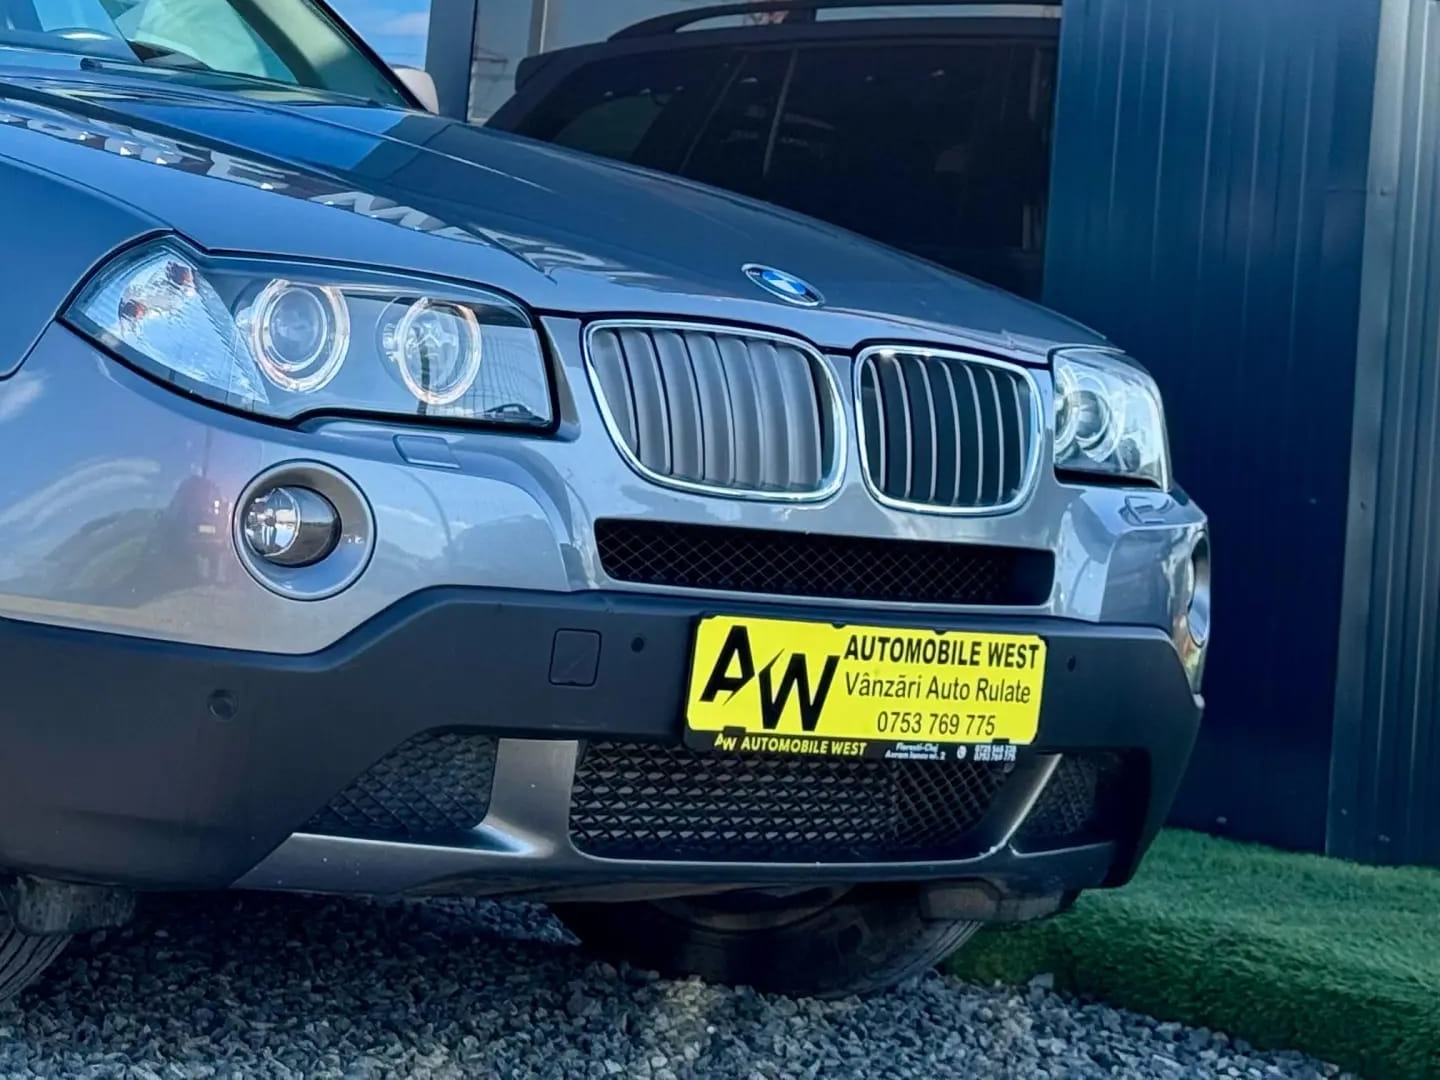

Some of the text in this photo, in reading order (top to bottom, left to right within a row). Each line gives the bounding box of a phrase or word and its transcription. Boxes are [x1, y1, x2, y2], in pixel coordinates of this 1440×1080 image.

[843, 634, 1040, 670] AUTOMOBILE WEST
[699, 624, 841, 732] AW
[926, 675, 971, 701] Auto
[975, 677, 1031, 704] Rulate
[876, 710, 996, 736] 0753 769 775
[740, 736, 827, 755] AUTOMOBILE
[831, 741, 868, 756] WEST
